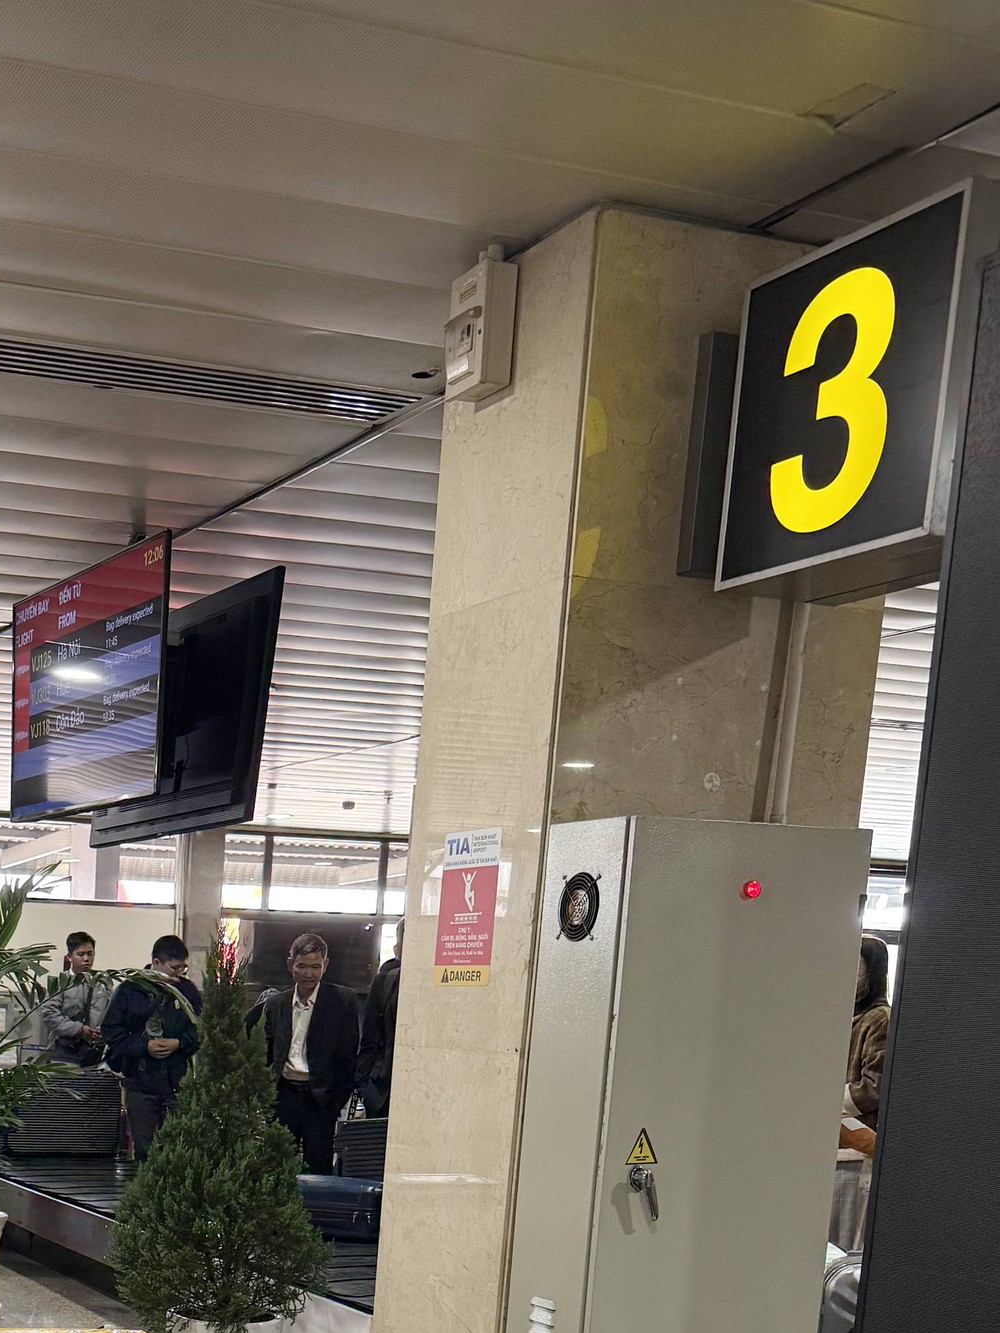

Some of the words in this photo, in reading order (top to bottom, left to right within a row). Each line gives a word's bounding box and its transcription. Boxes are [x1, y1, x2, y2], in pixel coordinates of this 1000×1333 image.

[770, 266, 896, 533] 3
[143, 545, 164, 567] 12:06
[38, 598, 50, 616] BAY
[58, 610, 76, 630] FROM
[105, 620, 115, 633] Bag
[115, 614, 132, 629] delivery
[132, 603, 154, 623] expected
[15, 629, 34, 648] FLIGHT
[31, 650, 52, 673] VJ125
[129, 682, 150, 699] expected
[30, 718, 51, 740] VJ118
[447, 837, 470, 856] TIA
[450, 970, 482, 982] DANGER
